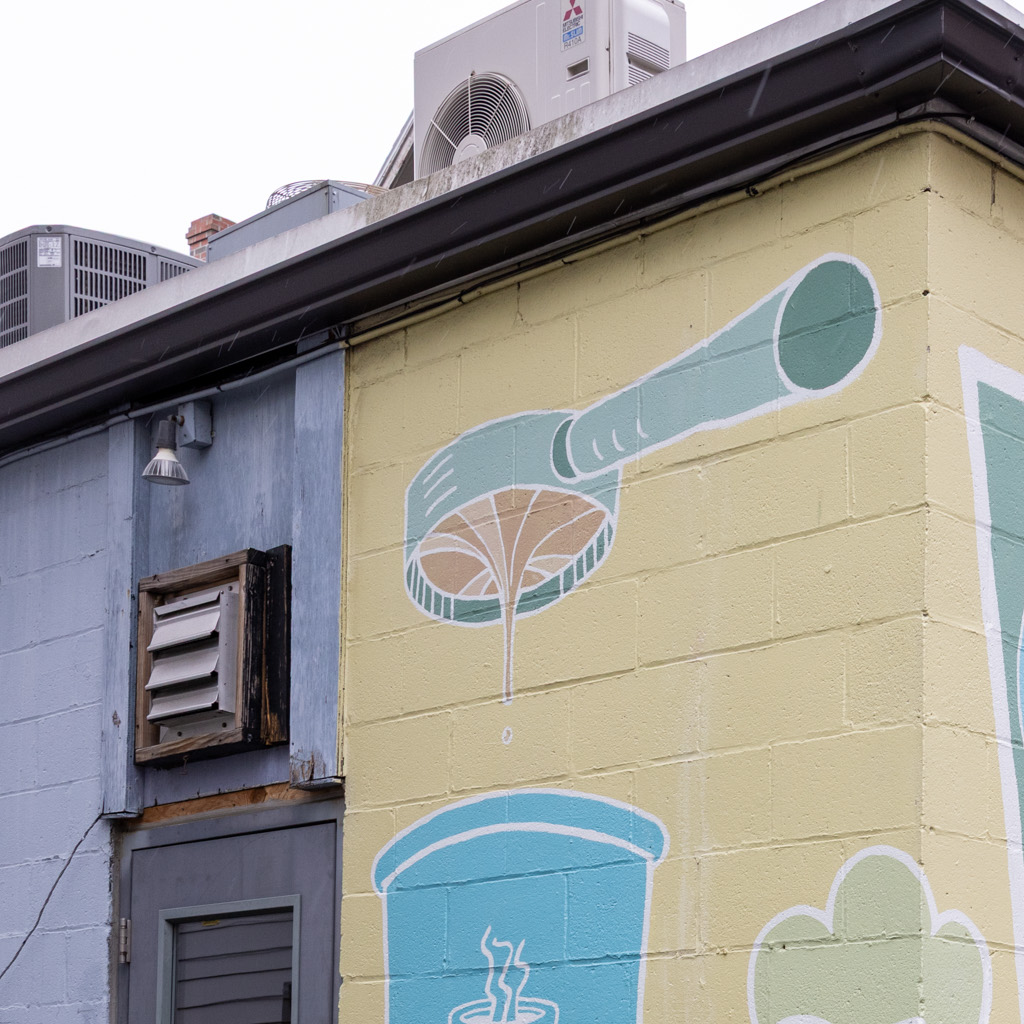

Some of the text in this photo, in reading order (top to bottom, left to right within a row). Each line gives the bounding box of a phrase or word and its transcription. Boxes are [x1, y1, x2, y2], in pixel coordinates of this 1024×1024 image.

[562, 14, 584, 27] MITSUBISHI
[562, 21, 581, 33] ELECTRIC
[563, 36, 582, 50] R410A
